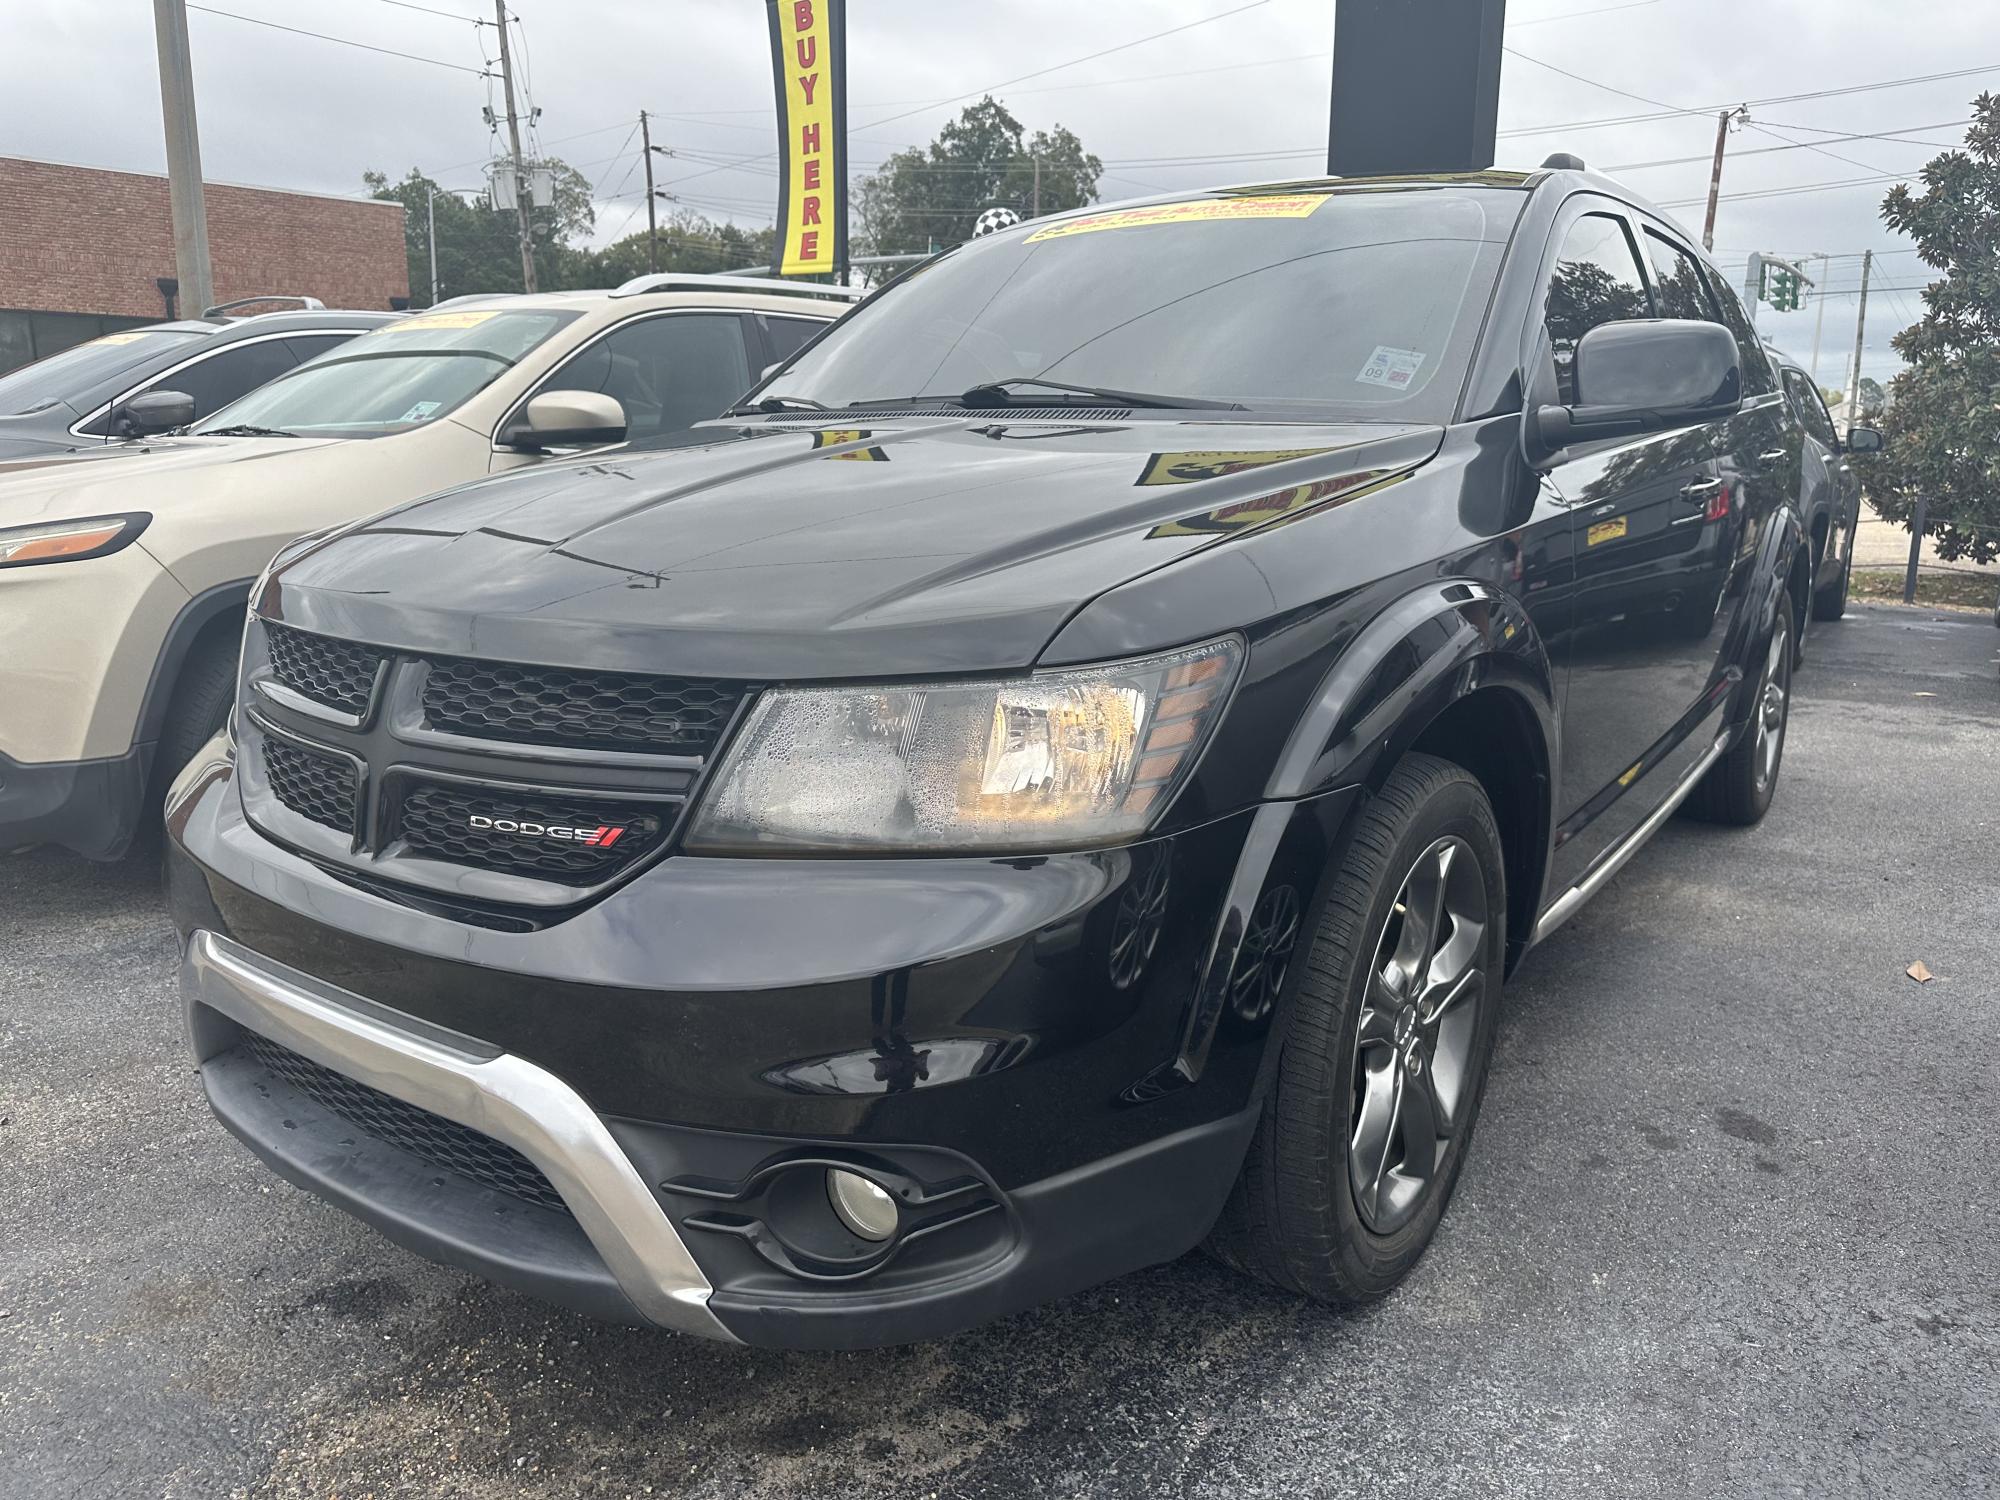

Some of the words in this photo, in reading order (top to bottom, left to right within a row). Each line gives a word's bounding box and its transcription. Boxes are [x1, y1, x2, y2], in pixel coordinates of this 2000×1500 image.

[793, 0, 819, 105] BUY
[799, 122, 822, 261] HERE
[1364, 367, 1383, 378] 09
[469, 815, 600, 842] DODGE
